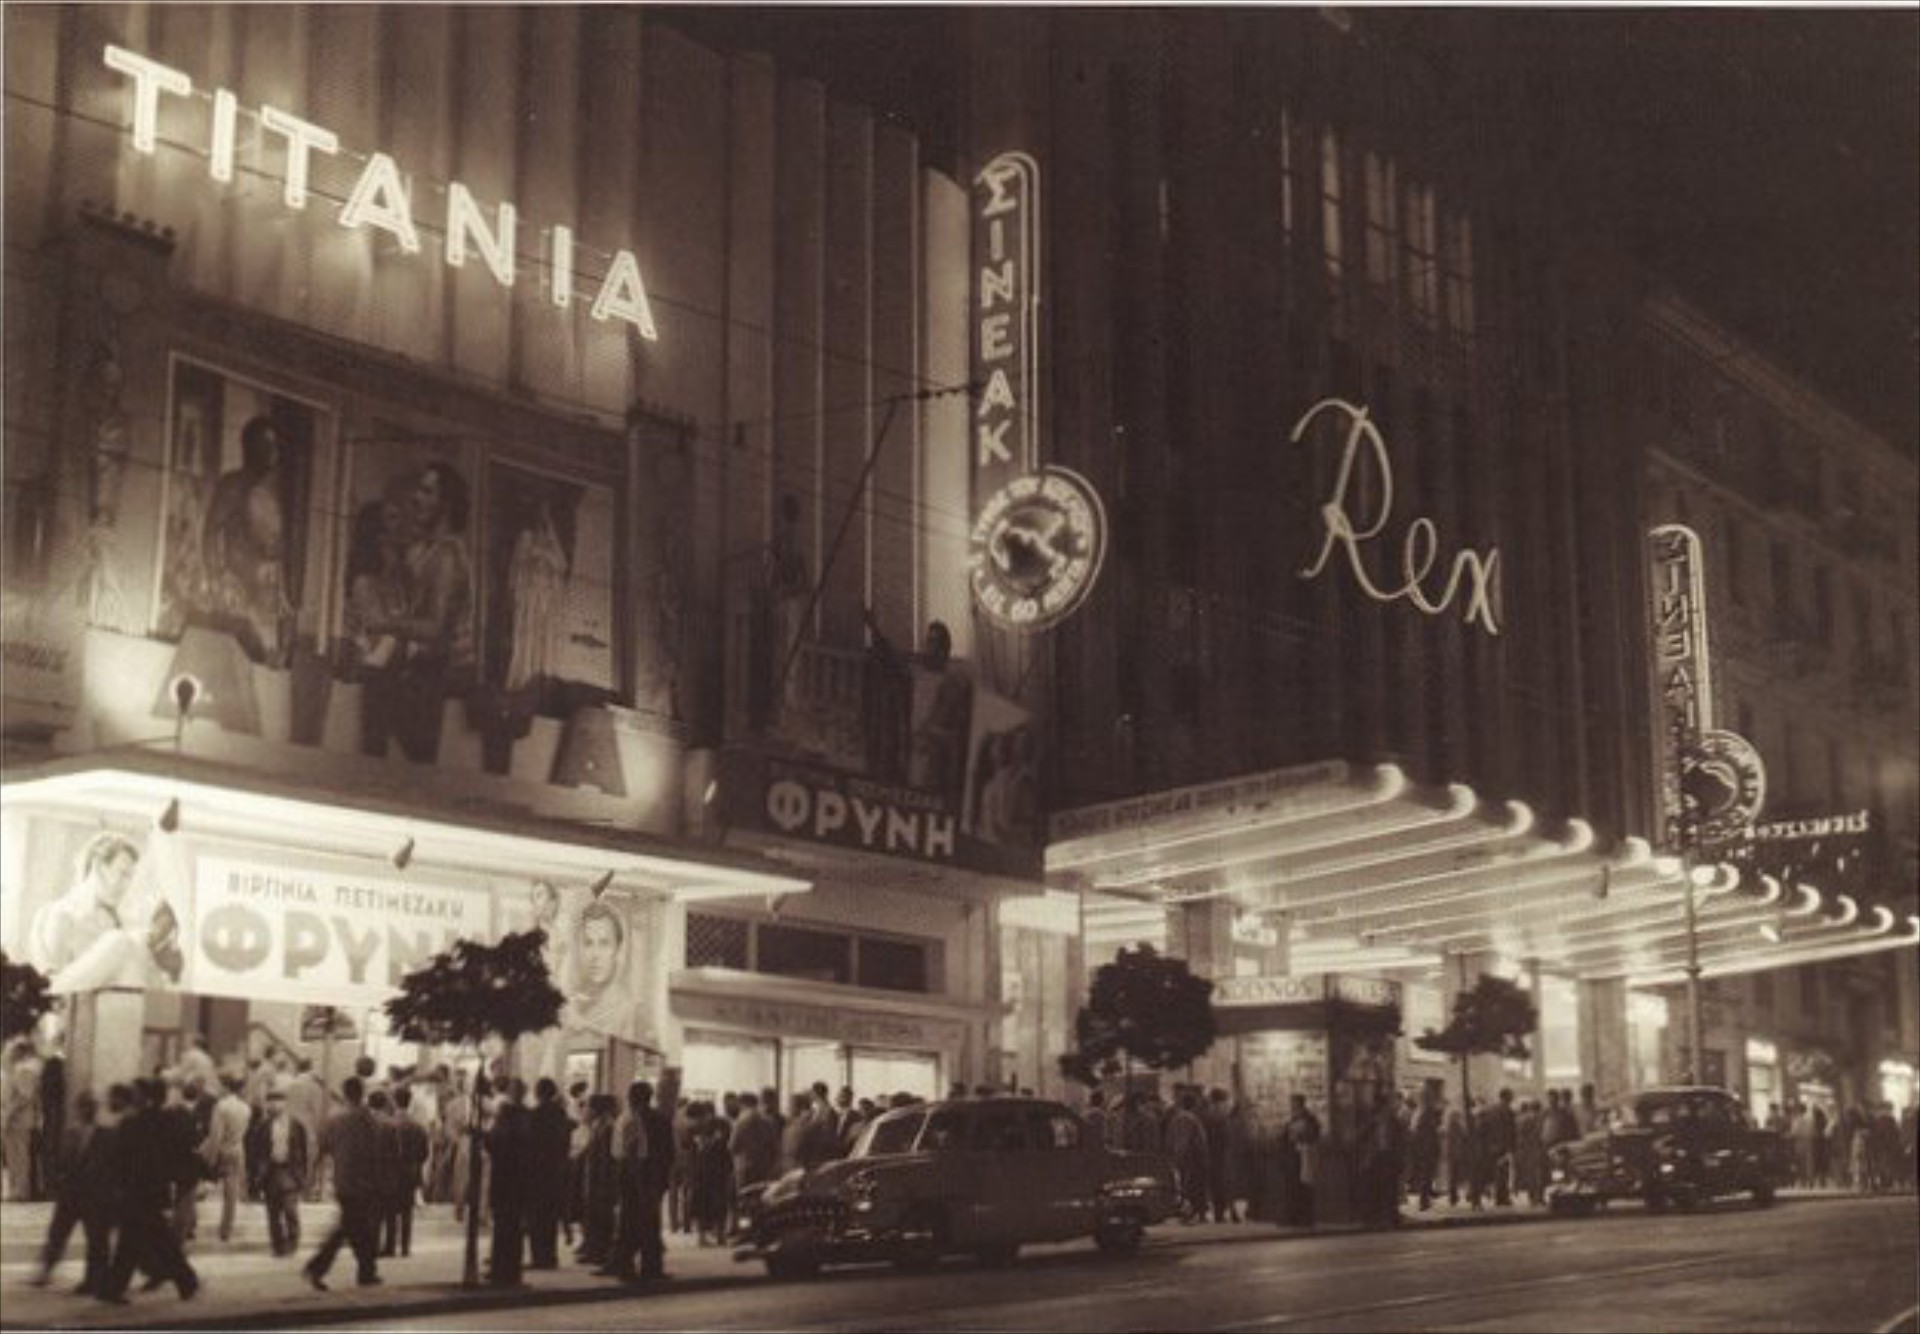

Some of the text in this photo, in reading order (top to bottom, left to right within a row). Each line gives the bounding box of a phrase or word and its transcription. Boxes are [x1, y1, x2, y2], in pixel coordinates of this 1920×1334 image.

[103, 44, 658, 341] TITANIA
[977, 166, 1018, 466] ΣΙΝΕΑΚ
[1290, 399, 1503, 635] Rex
[766, 782, 956, 857] ΦΡΥΝΗ
[200, 902, 486, 986] ΦΡΥΝ
